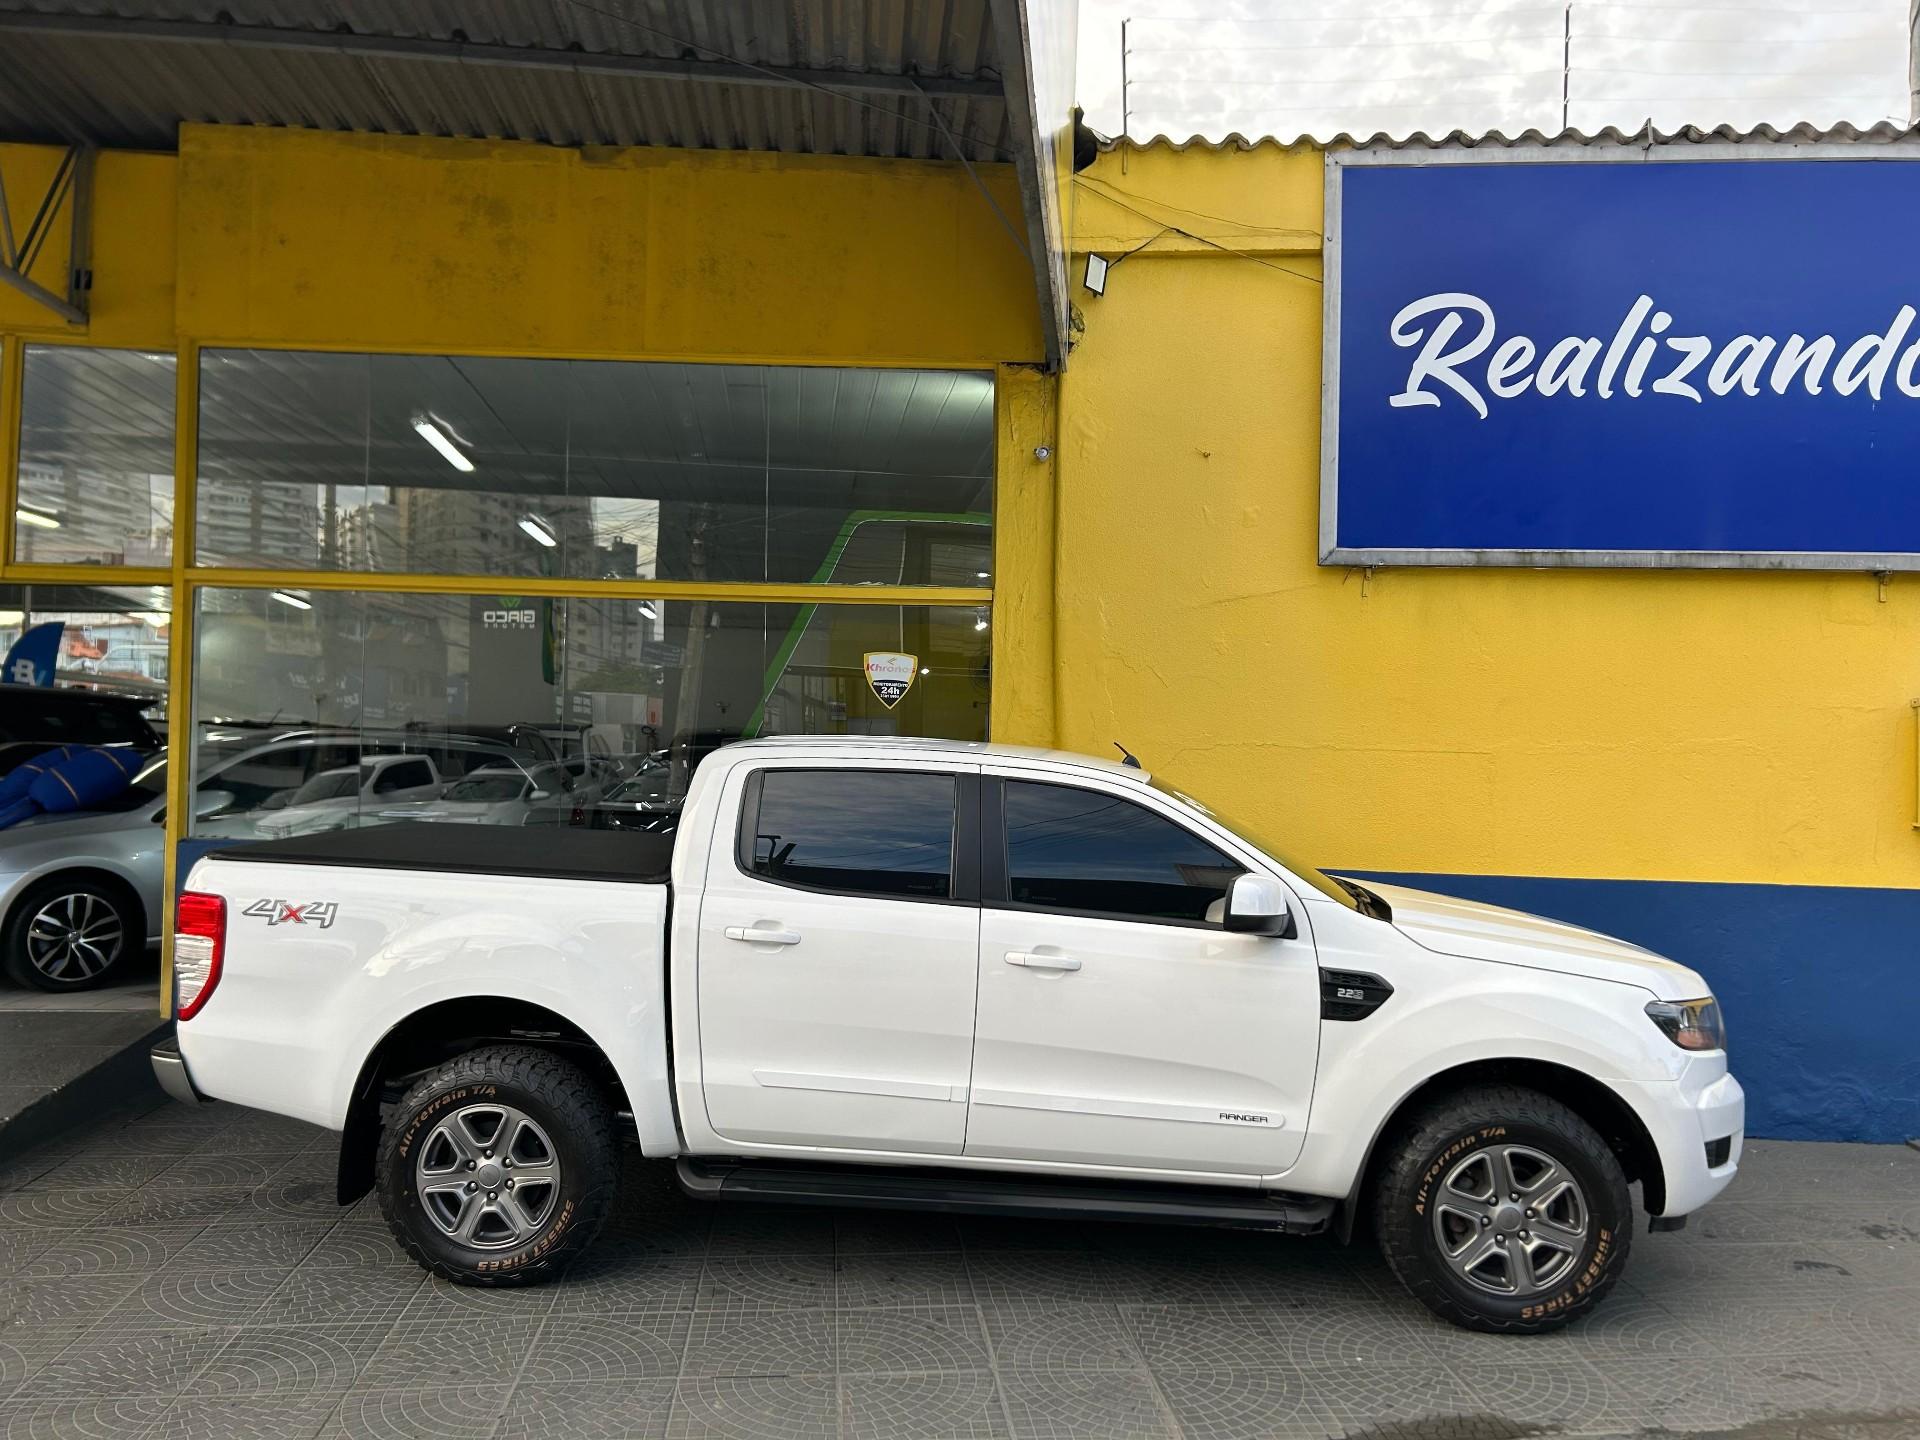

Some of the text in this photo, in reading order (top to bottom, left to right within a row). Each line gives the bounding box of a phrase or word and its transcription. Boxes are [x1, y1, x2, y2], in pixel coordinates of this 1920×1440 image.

[881, 686, 900, 694] 24h
[400, 1085, 496, 1159] All-Terrain T/A
[1219, 1112, 1268, 1123] RANGER
[1415, 1127, 1506, 1216] All-Terrain T/A
[477, 1199, 575, 1271] SUNSET TIRES
[1521, 1227, 1611, 1318] SUNSET TIRES
